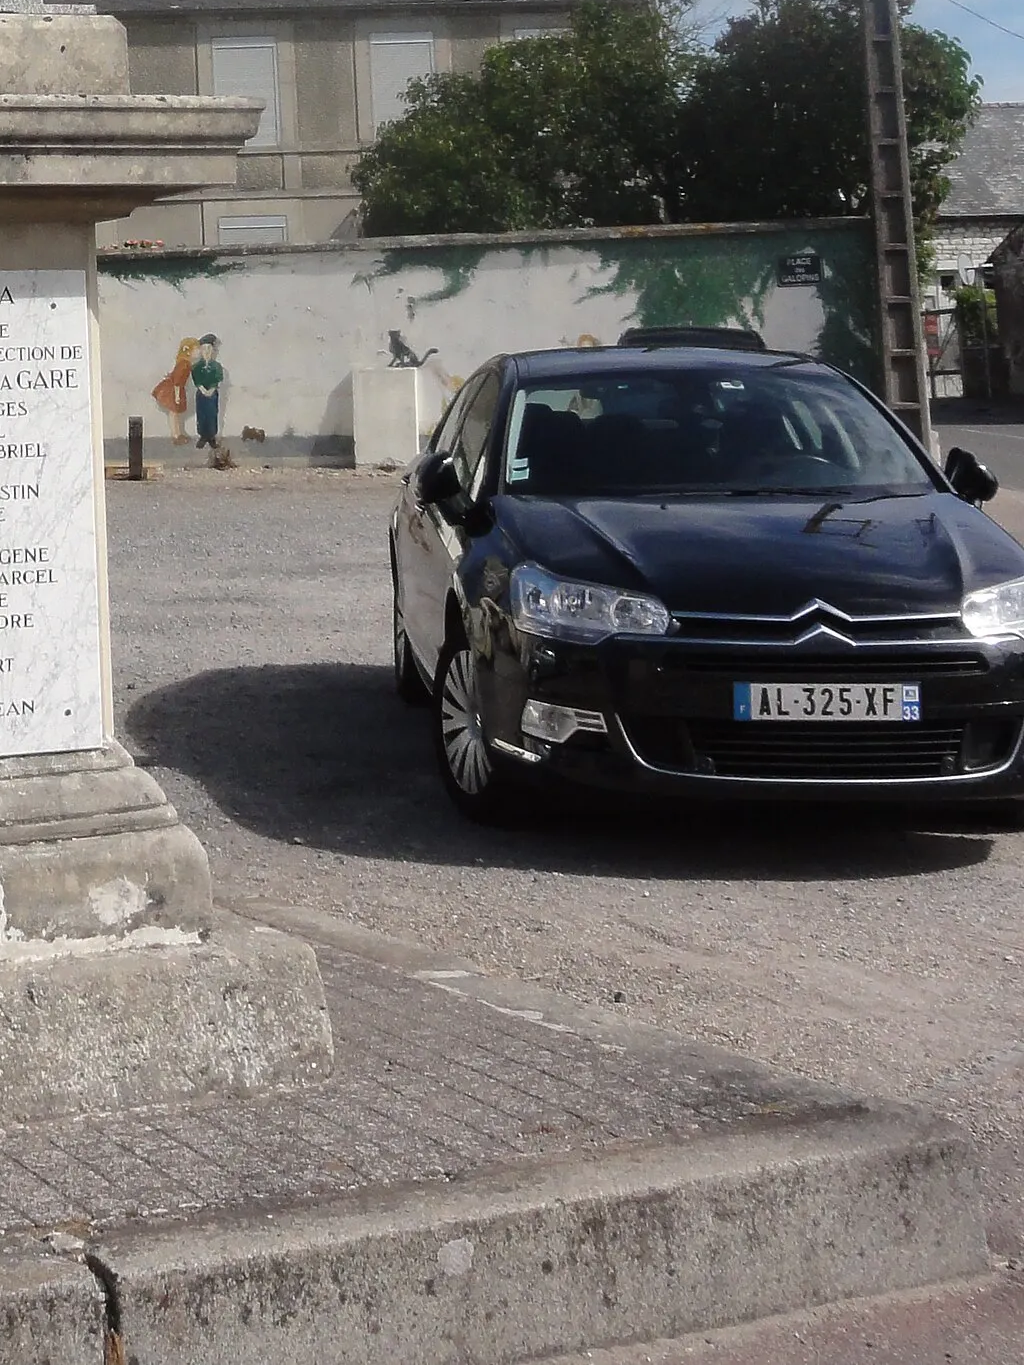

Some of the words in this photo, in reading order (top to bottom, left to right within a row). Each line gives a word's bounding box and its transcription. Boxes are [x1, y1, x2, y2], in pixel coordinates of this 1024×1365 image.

[60, 345, 83, 360] DE
[16, 368, 79, 390] GARE
[759, 688, 895, 716] AL-325-XF
[903, 706, 920, 720] 33
